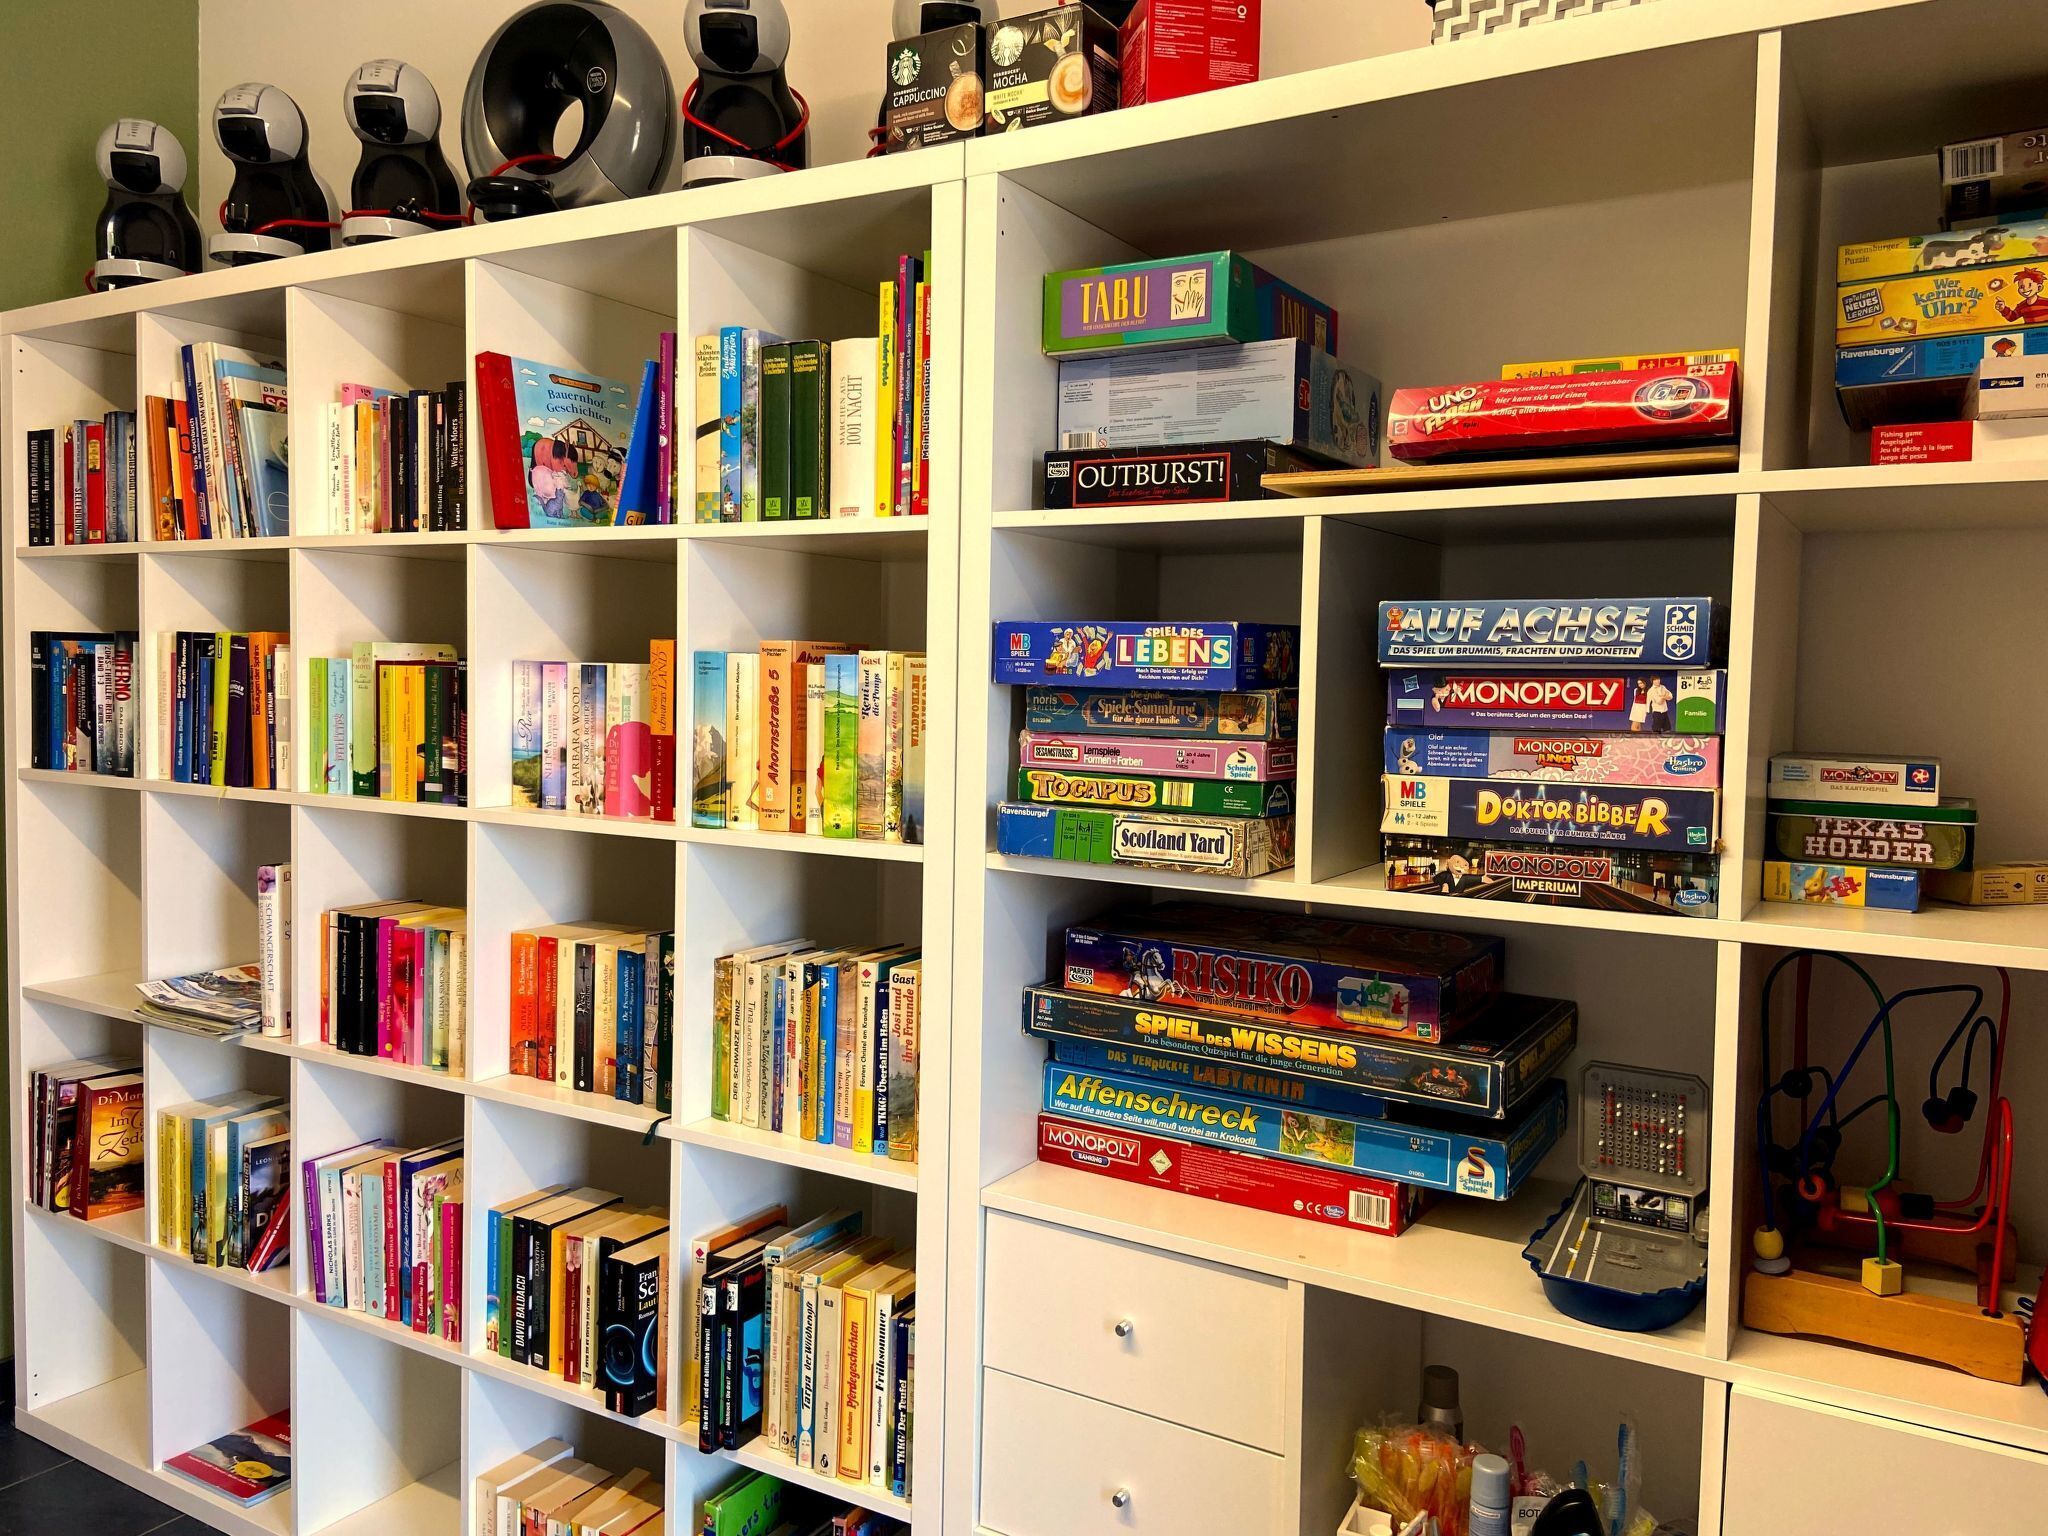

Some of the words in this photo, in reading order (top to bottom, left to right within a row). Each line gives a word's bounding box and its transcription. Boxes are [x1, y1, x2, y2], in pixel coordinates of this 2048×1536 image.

[993, 72, 1028, 89] MOCHA
[893, 87, 946, 107] CAPPUCCINO
[1844, 243, 1899, 256] Ravensburger
[1933, 278, 1961, 289] Wer
[1080, 275, 1149, 323] TABU
[1845, 297, 1879, 312] NEUES
[1913, 288, 1962, 305] kennt
[1965, 287, 1984, 300] die
[1847, 305, 1880, 319] LERNEN
[1922, 300, 1978, 319] Uhr?
[1841, 346, 1905, 359] Ravensburger
[547, 389, 608, 412] Bauernhof-
[847, 376, 862, 417] NACHT
[1428, 387, 1478, 411] UNO
[1550, 393, 1563, 401] auf
[546, 402, 613, 426] Geschichten
[189, 418, 197, 454] Kochbuch
[847, 420, 861, 445] 1001
[1905, 430, 1923, 438] game
[1880, 438, 1913, 446] Angelspiel
[1902, 445, 1921, 453] pêche
[1048, 462, 1069, 470] PARKER
[1879, 454, 1898, 462] Juego
[1078, 459, 1225, 489] OUTBURST!
[1667, 606, 1695, 624] FX
[1145, 627, 1177, 637] SPIEL
[1181, 628, 1204, 638] DES
[1392, 607, 1486, 643] AUF
[1488, 606, 1650, 643] ACHSE
[1667, 625, 1694, 633] SCHMID
[1011, 633, 1031, 650] MB
[1119, 639, 1230, 664] LEBENS
[1392, 646, 1411, 655] DAS
[1412, 646, 1437, 655] SPIEL
[1439, 646, 1454, 655] UM
[1456, 646, 1504, 656] BRUMMIS,
[1505, 646, 1556, 655] FRACHTEN
[1558, 647, 1583, 655] UND
[1585, 647, 1637, 656] MONETEN
[860, 656, 881, 665] Gast
[771, 669, 780, 680] 5
[1033, 696, 1057, 705] noris
[1450, 682, 1619, 705] MONOPOLY
[1097, 699, 1199, 723] Spiele-Sammlung
[1112, 715, 1124, 724] für
[1125, 715, 1133, 723] die
[1156, 715, 1180, 724] Familie
[767, 686, 780, 785] Ahornstraße
[1084, 746, 1120, 756] Lernspiele
[1517, 741, 1599, 754] MONOPOLY
[572, 728, 580, 786] BARBARA
[1538, 754, 1576, 765] JUNIOR
[1669, 756, 1703, 768] Hasbro
[1226, 764, 1256, 773] Schmidt
[1230, 770, 1252, 779] Spiele
[1031, 773, 1152, 803] TOCAPUS
[1401, 781, 1426, 799] MB
[1001, 807, 1049, 818] Ravensburger
[1400, 800, 1426, 808] SPIELE
[1815, 818, 1924, 839] TEXAS
[1121, 828, 1188, 852] Scotland
[1190, 833, 1225, 854] Yard
[1805, 836, 1933, 863] HOLDER
[1489, 854, 1608, 880] MONOPOLY
[1869, 872, 1914, 881] Ravensburger
[1516, 879, 1577, 893] IMPERIUM
[1680, 893, 1707, 901] Hasbro
[265, 903, 274, 992] SCHWANGERSCHAFT
[892, 973, 915, 985] Gast
[1069, 966, 1093, 976] PARKER
[1171, 948, 1314, 1009] RISIKO
[892, 987, 901, 1011] und
[903, 989, 914, 1037] Freunde
[892, 1012, 901, 1037] Josi
[1134, 1012, 1204, 1044] SPIEL
[1206, 1034, 1231, 1047] DES
[1231, 1027, 1357, 1069] WISSENS
[903, 1039, 913, 1063] ihre
[1144, 1034, 1158, 1045] Das
[1160, 1038, 1200, 1052] besondere
[1201, 1044, 1239, 1059] Quizspiel
[1240, 1050, 1252, 1061] für
[1254, 1054, 1268, 1064] die
[1270, 1057, 1293, 1069] junge
[1295, 1059, 1343, 1076] Generation
[1056, 1074, 1261, 1133] Affenschreck
[110, 1117, 129, 1128] Im
[1054, 1100, 1069, 1109] Wer
[1070, 1102, 1082, 1112] auf
[1082, 1104, 1095, 1115] die
[1095, 1106, 1122, 1119] andere
[1123, 1112, 1143, 1124] Seite
[1178, 1122, 1204, 1135] vorbei
[1205, 1129, 1218, 1138] am
[1219, 1130, 1258, 1146] Krokodil.
[1048, 1128, 1136, 1159] MONOPOLY
[1078, 1154, 1103, 1164] BANKING
[1459, 1175, 1492, 1189] Schmidt
[1462, 1183, 1488, 1195] Spiele
[516, 1275, 526, 1318] BALDACCI
[515, 1319, 525, 1347] DAVID
[875, 1309, 886, 1392] Frühsommer
